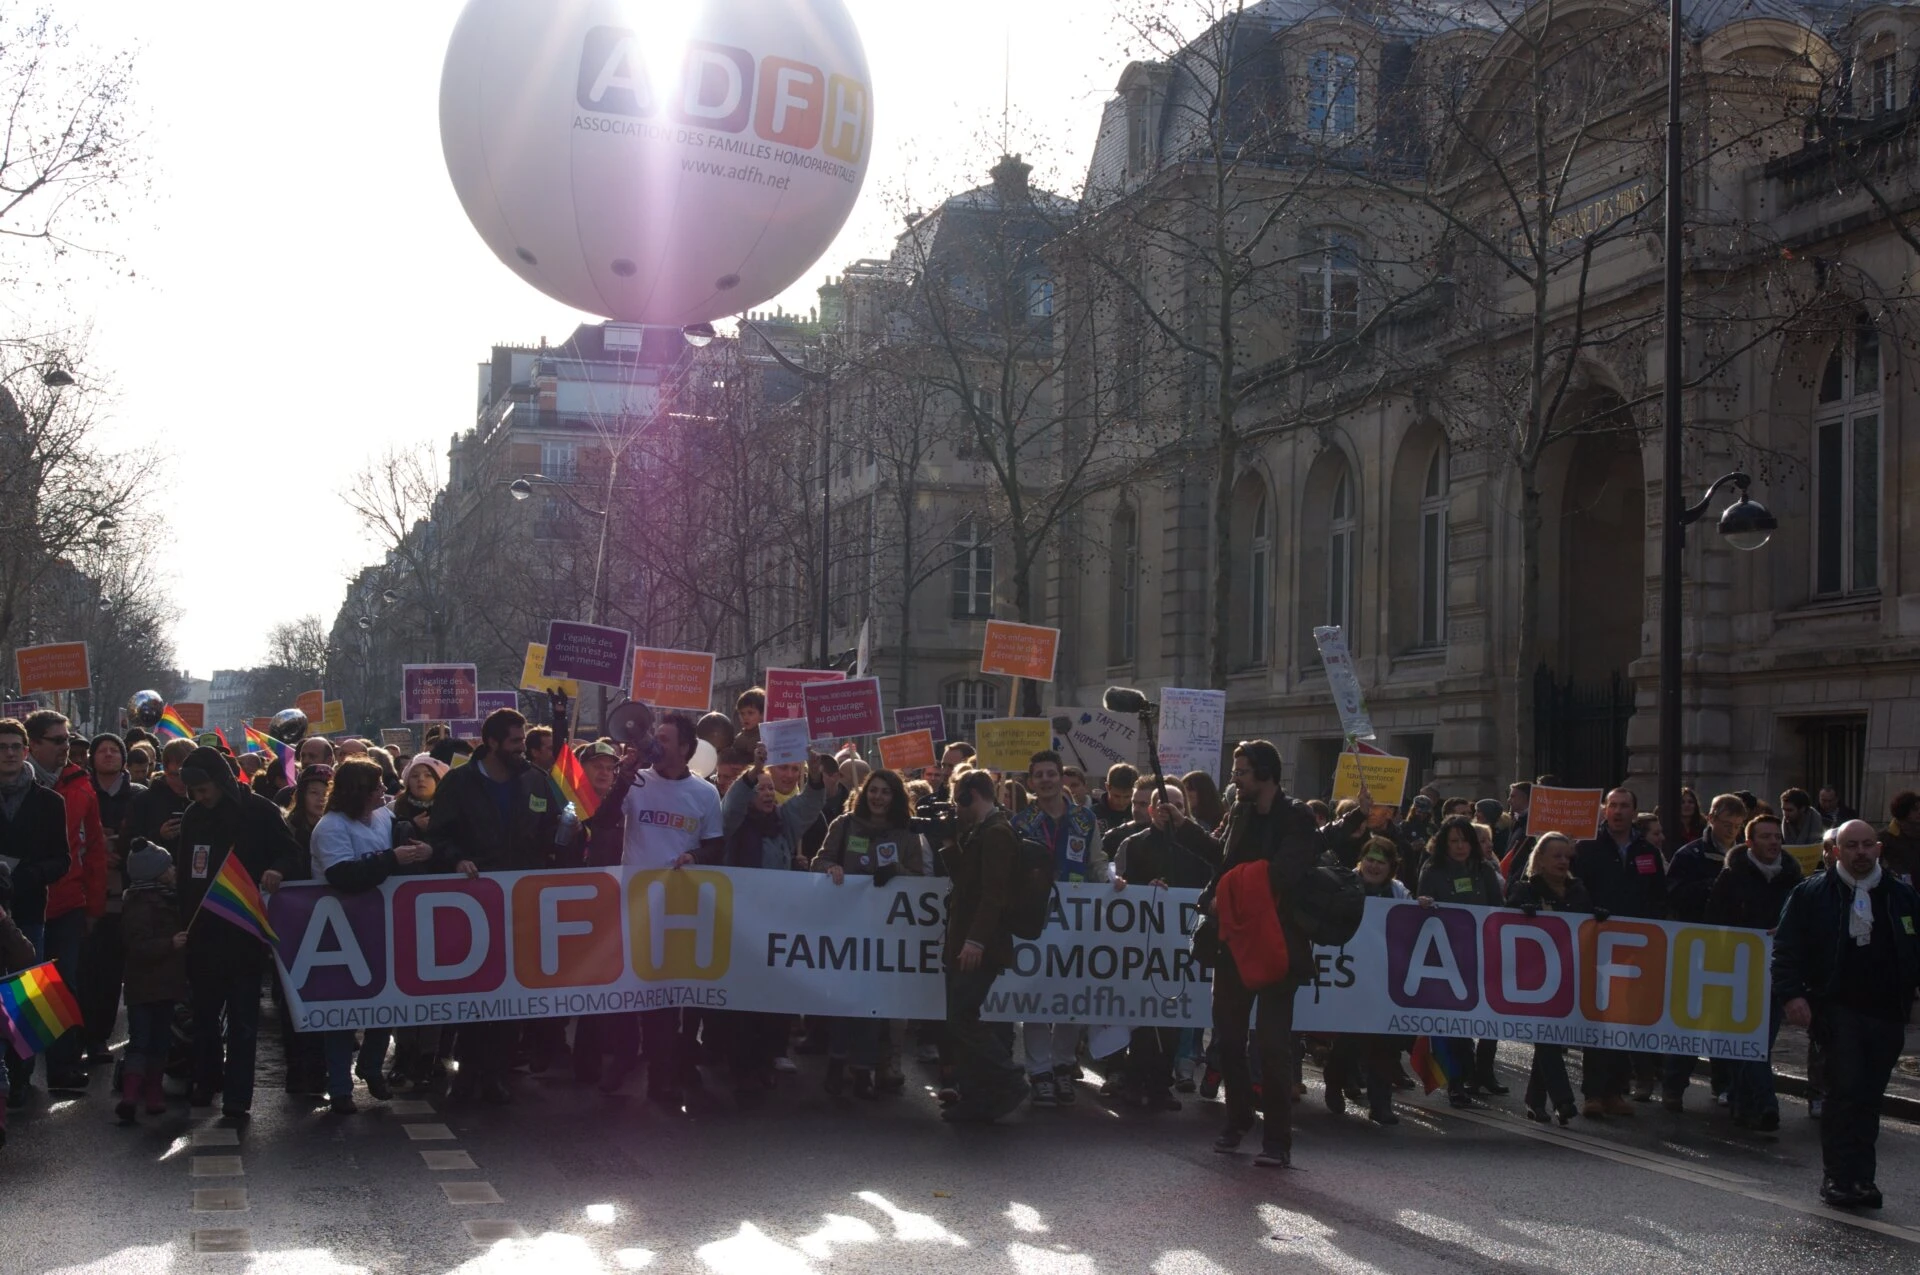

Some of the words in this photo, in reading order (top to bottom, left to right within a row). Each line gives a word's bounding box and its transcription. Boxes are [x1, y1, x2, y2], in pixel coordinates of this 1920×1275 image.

[587, 34, 866, 157] ADFH
[573, 115, 671, 143] ASSOCIATION
[675, 128, 705, 148] DES
[707, 135, 772, 161] FAMILLES
[773, 148, 857, 184] HOMOPARENTALES
[680, 156, 793, 191] www.adfh.net
[554, 643, 580, 654] droits
[582, 646, 602, 657] n'est
[602, 650, 618, 661] pas
[563, 632, 598, 645] L'égalité
[598, 638, 614, 648] des
[559, 654, 576, 663] une
[577, 657, 611, 668] menace
[412, 687, 436, 696] droits
[437, 687, 455, 696] n'est
[455, 688, 470, 698] pas
[418, 677, 449, 687] L'égalité
[449, 677, 464, 686] des
[782, 691, 794, 699] du
[418, 697, 434, 705] une
[434, 697, 465, 705] menace
[820, 705, 831, 713] du
[832, 701, 865, 712] courage
[826, 711, 867, 724] parlement
[1095, 712, 1136, 741] TAPETTE
[640, 811, 699, 832] ADFH
[886, 891, 1165, 934] ASATION
[292, 880, 717, 990] ADFH
[766, 931, 948, 975] FAMILLE
[1000, 943, 1356, 988] OMOPARES
[1402, 915, 1751, 1024] ADFH
[301, 1004, 408, 1030] OCIATION
[414, 1002, 452, 1023] DES
[457, 996, 550, 1021] FAMILLES
[554, 986, 727, 1015] HOMOPARENTALES
[983, 985, 1192, 1019] ww.adfh.net
[1388, 1014, 1499, 1039] ASSOCIATION
[1503, 1021, 1534, 1041] DES
[1536, 1023, 1600, 1046] FAMILLES
[1602, 1030, 1761, 1060] HOMOPARENTALES
